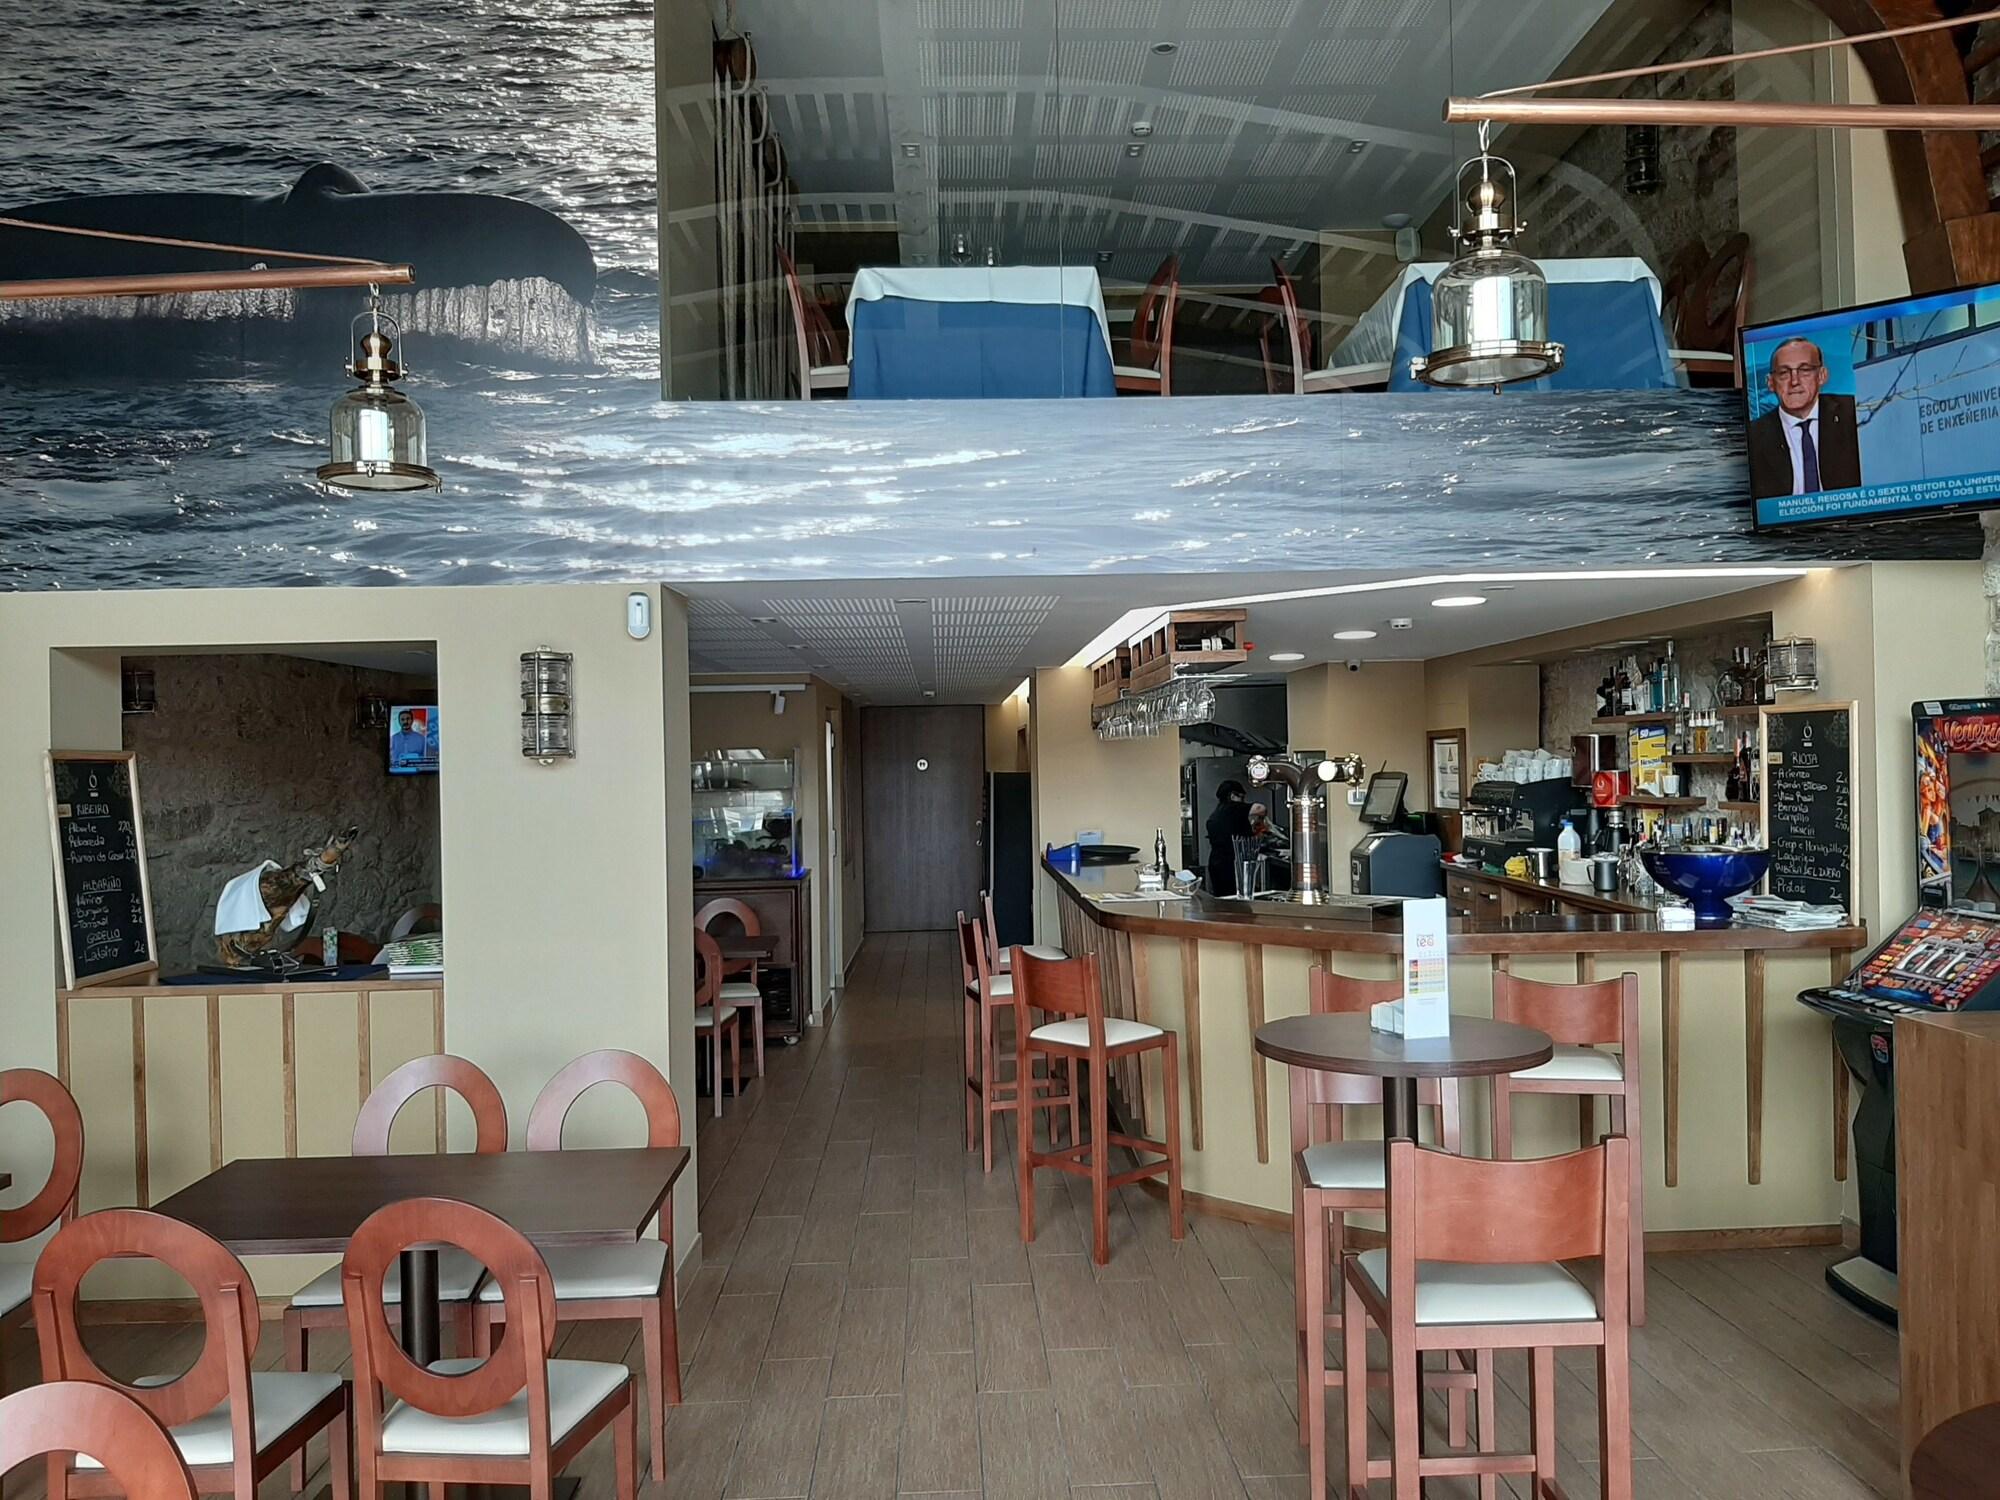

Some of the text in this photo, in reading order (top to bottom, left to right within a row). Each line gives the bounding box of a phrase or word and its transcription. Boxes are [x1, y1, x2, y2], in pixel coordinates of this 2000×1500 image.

[1919, 399, 1961, 418] ESCOLA
[1921, 420, 1934, 434] DE
[1778, 497, 1816, 508] MANUEL
[1818, 491, 1858, 503] REIGOSA
[1868, 489, 1876, 497] O
[1877, 485, 1909, 496] SEXTO
[1910, 481, 1946, 492] REITOR
[1948, 479, 1962, 488] DA
[1826, 502, 1841, 511] FOI
[1843, 494, 1913, 509] FUNDAMENTAL
[1914, 493, 1922, 501] O
[1924, 490, 1951, 499] VOTO
[1953, 487, 1974, 496] DOS
[1976, 484, 2000, 494] ESTU
[1792, 751, 1818, 765] RIOJA
